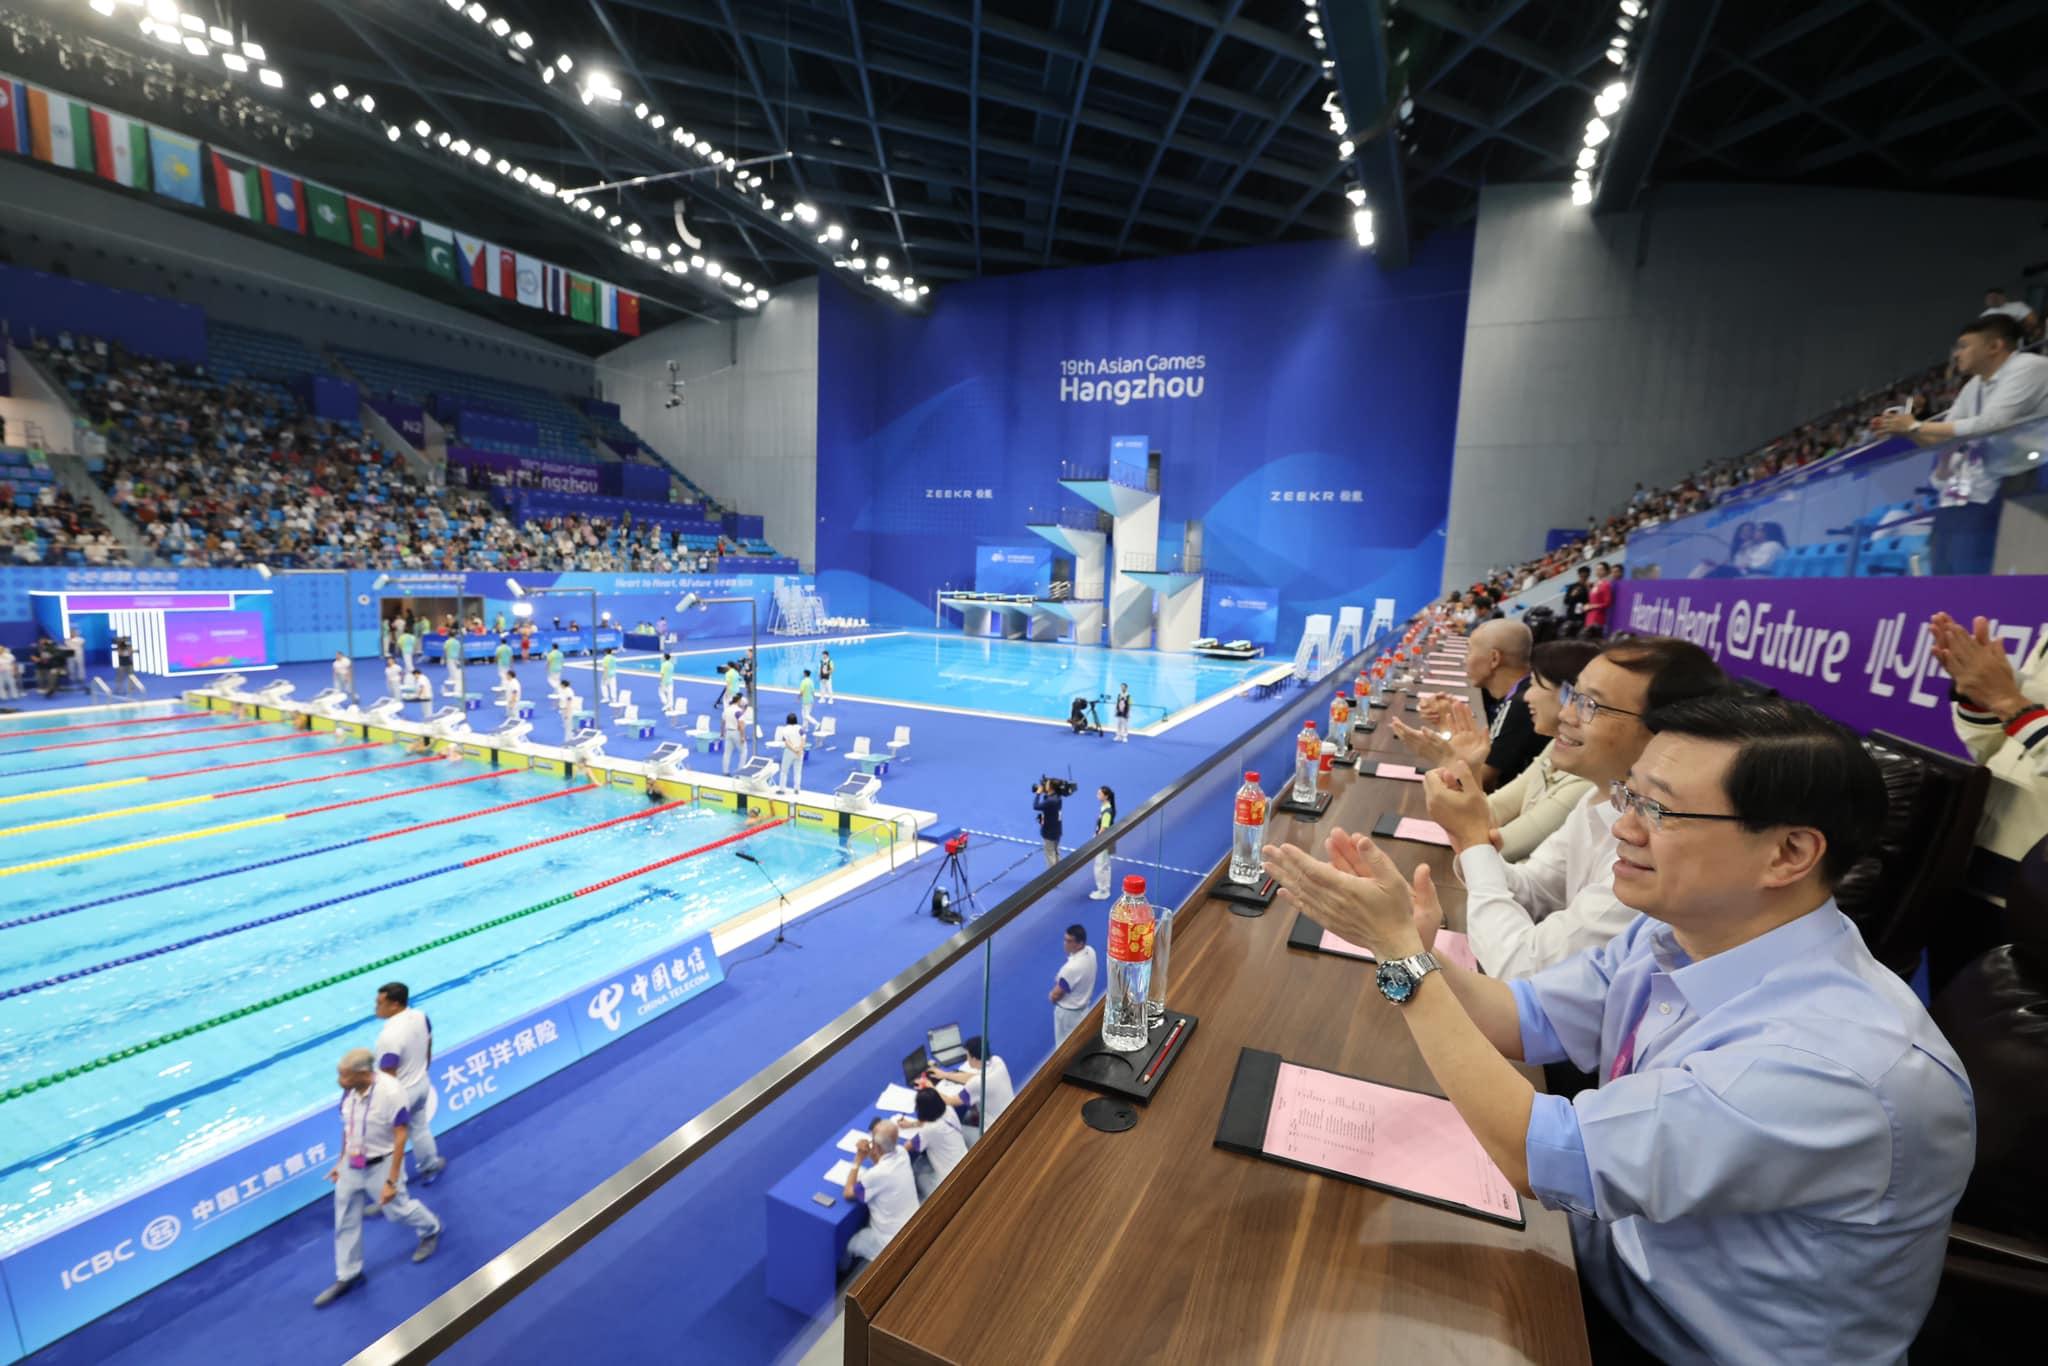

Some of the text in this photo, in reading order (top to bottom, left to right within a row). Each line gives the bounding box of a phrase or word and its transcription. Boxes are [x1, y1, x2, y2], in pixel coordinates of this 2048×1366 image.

[1060, 354, 1206, 376] 19th Asian Games
[1060, 372, 1205, 406] Hangzhou
[925, 488, 973, 499] ZEEKR
[1270, 490, 1336, 502] ZEEKR
[1629, 592, 1850, 683] Heart to Heart, @Future
[637, 972, 711, 1016] CHINA TELECOM
[440, 1019, 560, 1094] 太平洋保险
[448, 1075, 498, 1111] CPIC
[60, 1238, 136, 1290] ICBC
